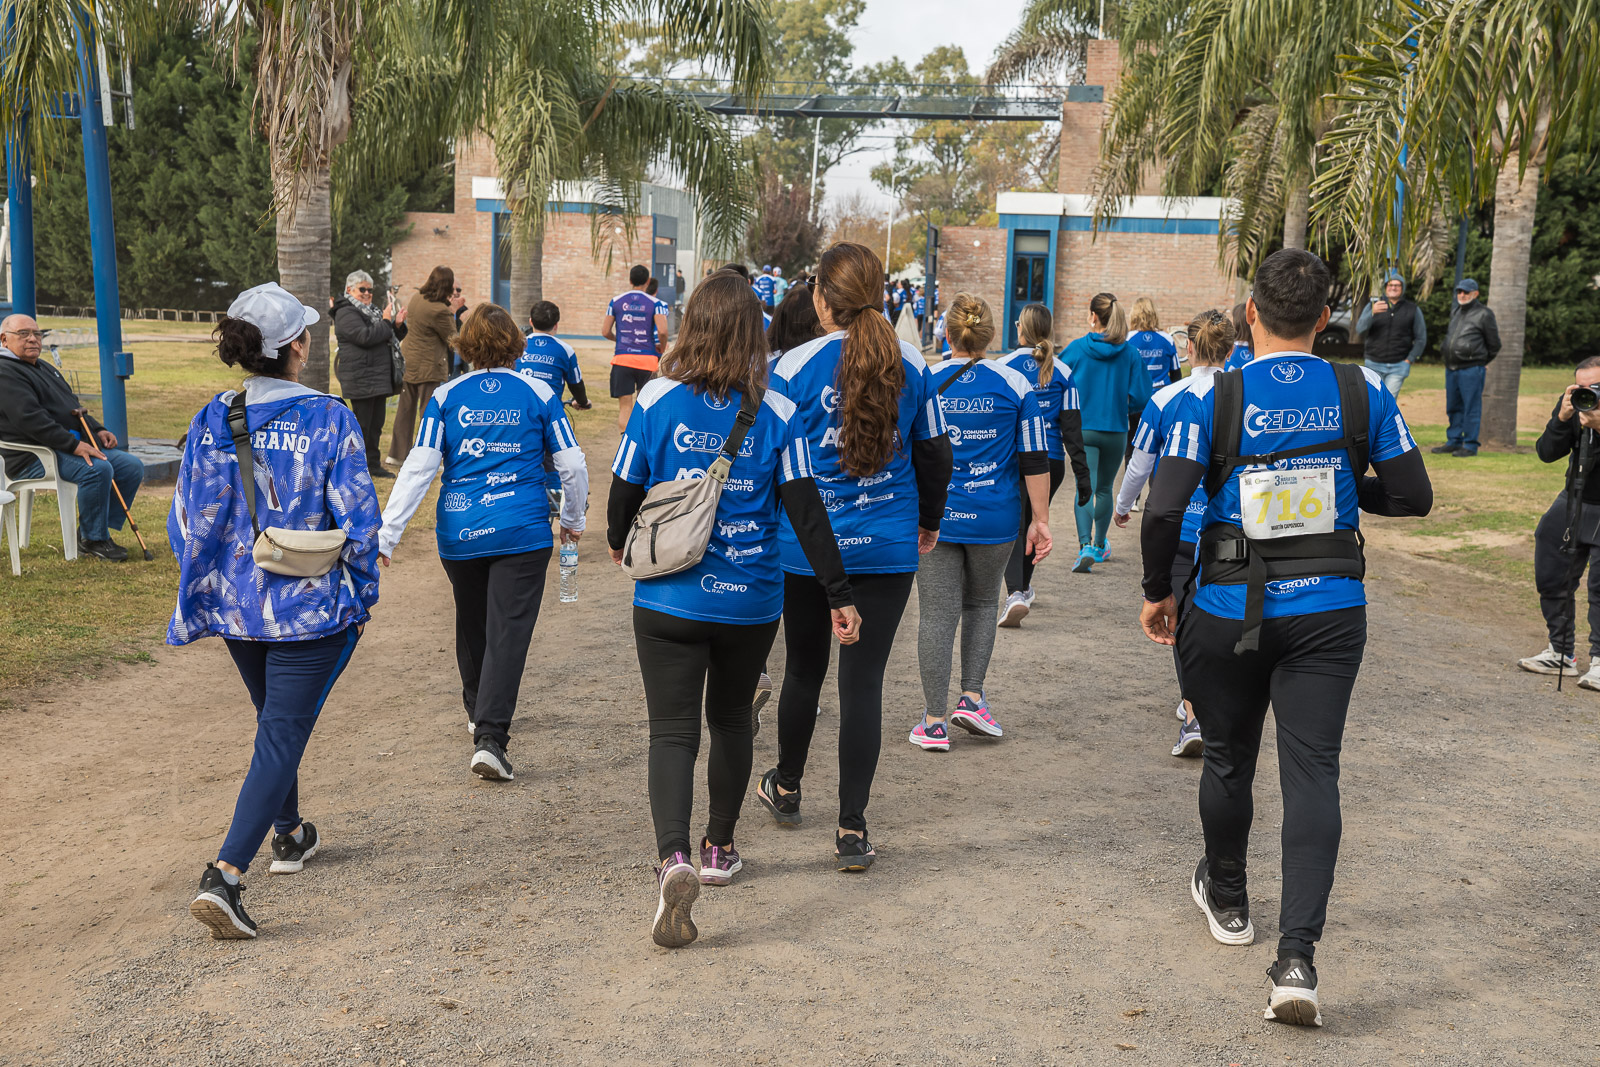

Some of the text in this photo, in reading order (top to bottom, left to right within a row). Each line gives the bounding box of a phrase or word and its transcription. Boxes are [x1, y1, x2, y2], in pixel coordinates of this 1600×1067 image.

[458, 407, 521, 426] CEDAR
[1244, 405, 1340, 435] CEDAR
[201, 427, 311, 454] BRANO
[674, 426, 755, 455] CEDR
[457, 438, 486, 458] AQ
[1290, 457, 1330, 465] COMUNA
[1274, 474, 1281, 486] 3
[722, 484, 754, 492] EQUITO
[1252, 487, 1323, 524] 716
[950, 511, 978, 520] CRONO
[468, 527, 496, 538] CRONO
[837, 536, 872, 546] CRONO
[713, 581, 748, 593] CRONO
[1279, 576, 1320, 590] CRONO
